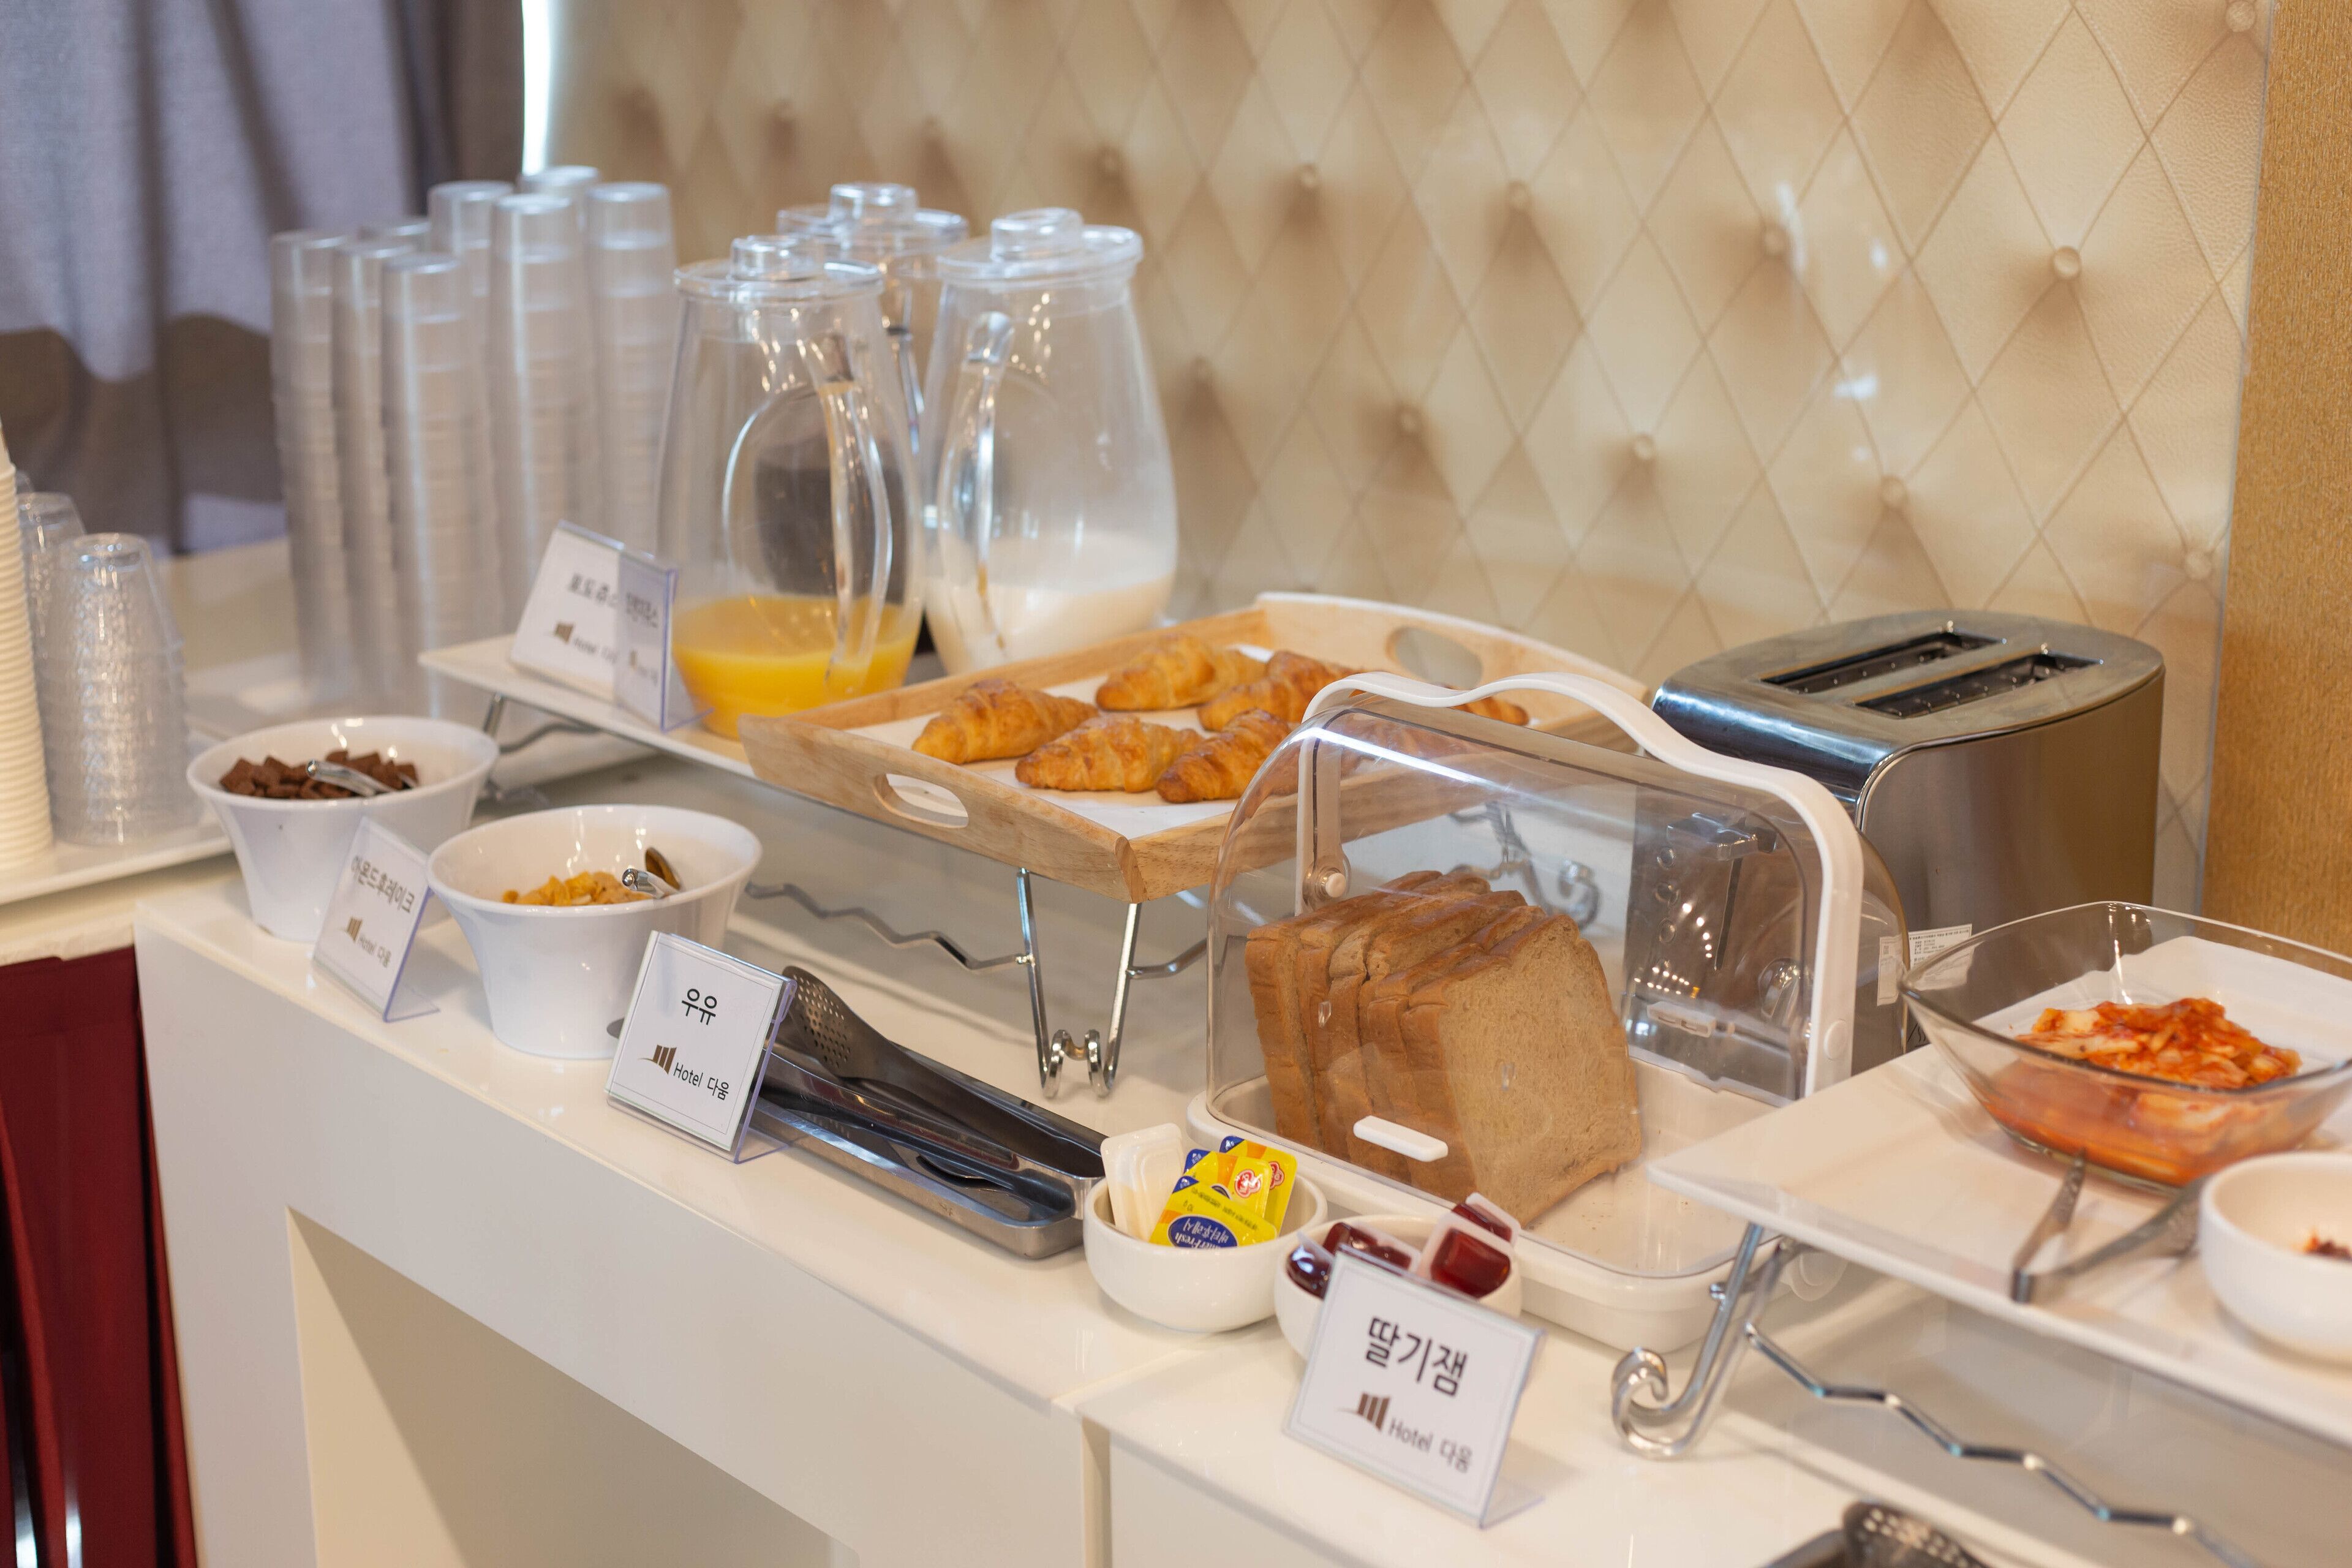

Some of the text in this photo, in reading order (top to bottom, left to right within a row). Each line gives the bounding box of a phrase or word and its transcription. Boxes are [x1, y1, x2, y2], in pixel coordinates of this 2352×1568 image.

[682, 989, 717, 1025] 우유
[673, 1061, 729, 1101] Hotel 다움
[1183, 1218, 1229, 1244] 버터후레시
[1365, 1316, 1468, 1398] 딸기잼
[1387, 1417, 1474, 1474] Hotel 다움
